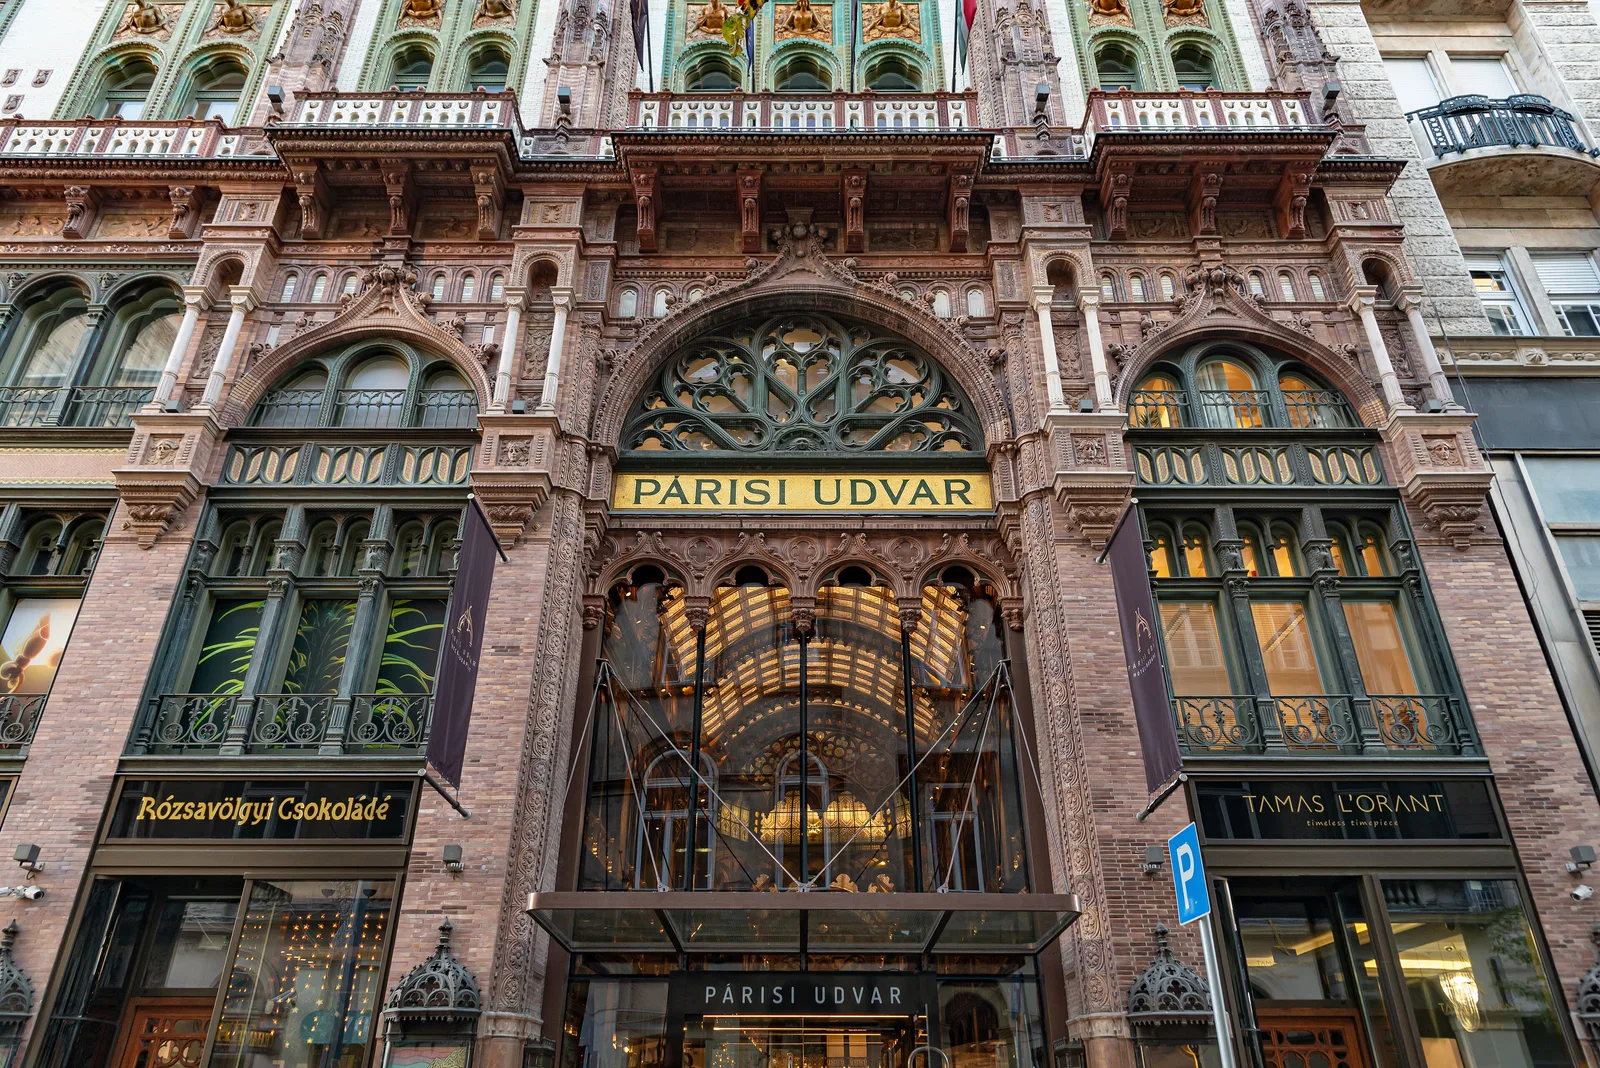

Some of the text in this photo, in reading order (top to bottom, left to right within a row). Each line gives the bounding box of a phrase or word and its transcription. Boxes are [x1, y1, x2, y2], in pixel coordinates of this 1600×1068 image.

[632, 475, 974, 506] PÁRISI UDVAR
[136, 794, 392, 826] Rózsavölgyi Csokoládé
[1242, 795, 1325, 813] TAMAS
[1306, 819, 1399, 828] timeless timepiece
[1176, 841, 1195, 910] P
[705, 983, 901, 1004] PÁRISI UDVAR
